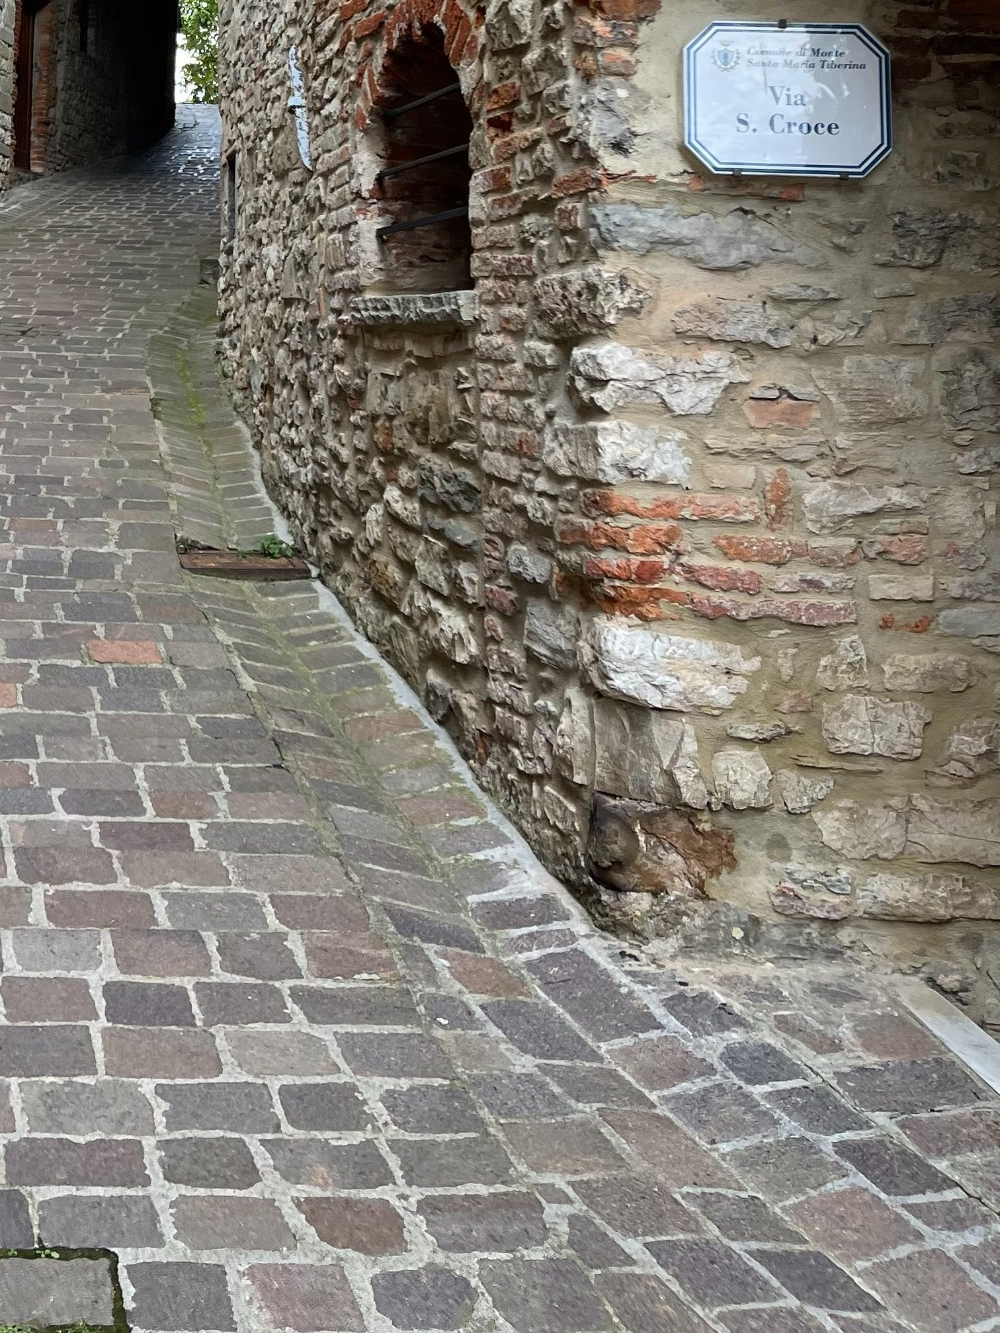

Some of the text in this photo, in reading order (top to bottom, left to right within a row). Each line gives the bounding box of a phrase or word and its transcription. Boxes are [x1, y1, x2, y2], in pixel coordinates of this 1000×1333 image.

[796, 46, 807, 57] di
[810, 48, 846, 58] Monte
[747, 57, 867, 70] Santa Maria Tiberina
[768, 85, 806, 106] Via
[736, 112, 840, 135] S. Croce
